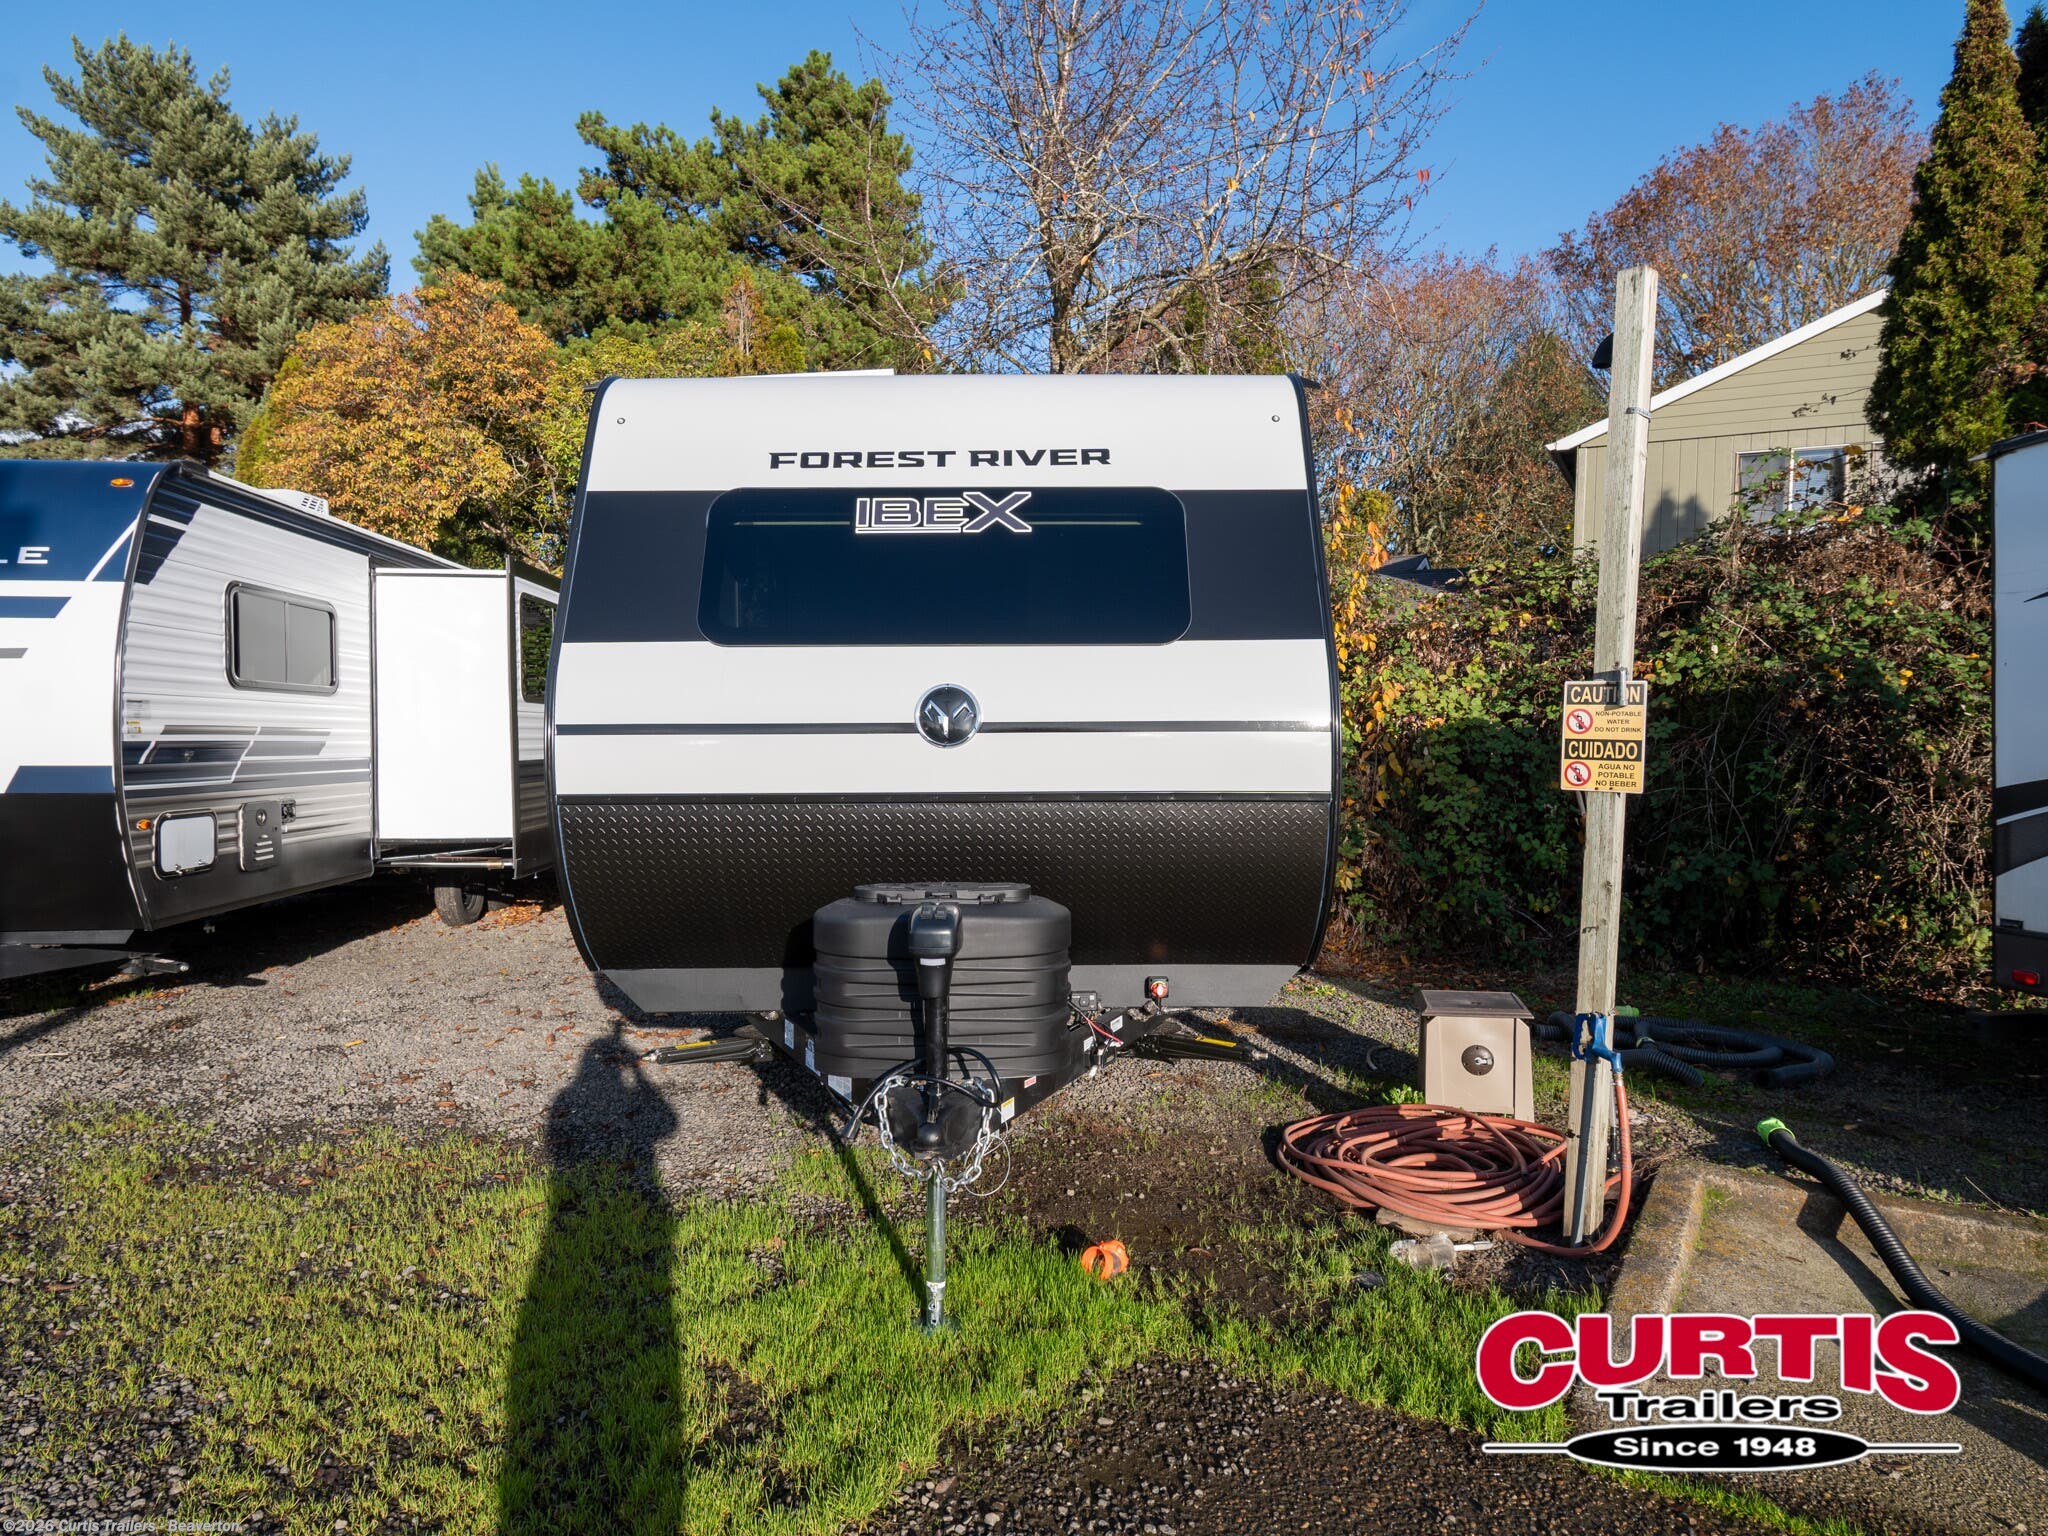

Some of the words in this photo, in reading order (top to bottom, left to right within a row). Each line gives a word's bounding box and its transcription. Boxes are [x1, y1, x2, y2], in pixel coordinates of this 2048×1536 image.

[768, 450, 957, 470] FOREST
[969, 448, 1112, 468] RIVER
[854, 491, 1032, 534] IBEX
[0, 546, 51, 565] E
[1568, 740, 1638, 760] CUIDADO
[1597, 771, 1635, 779] POTABLE
